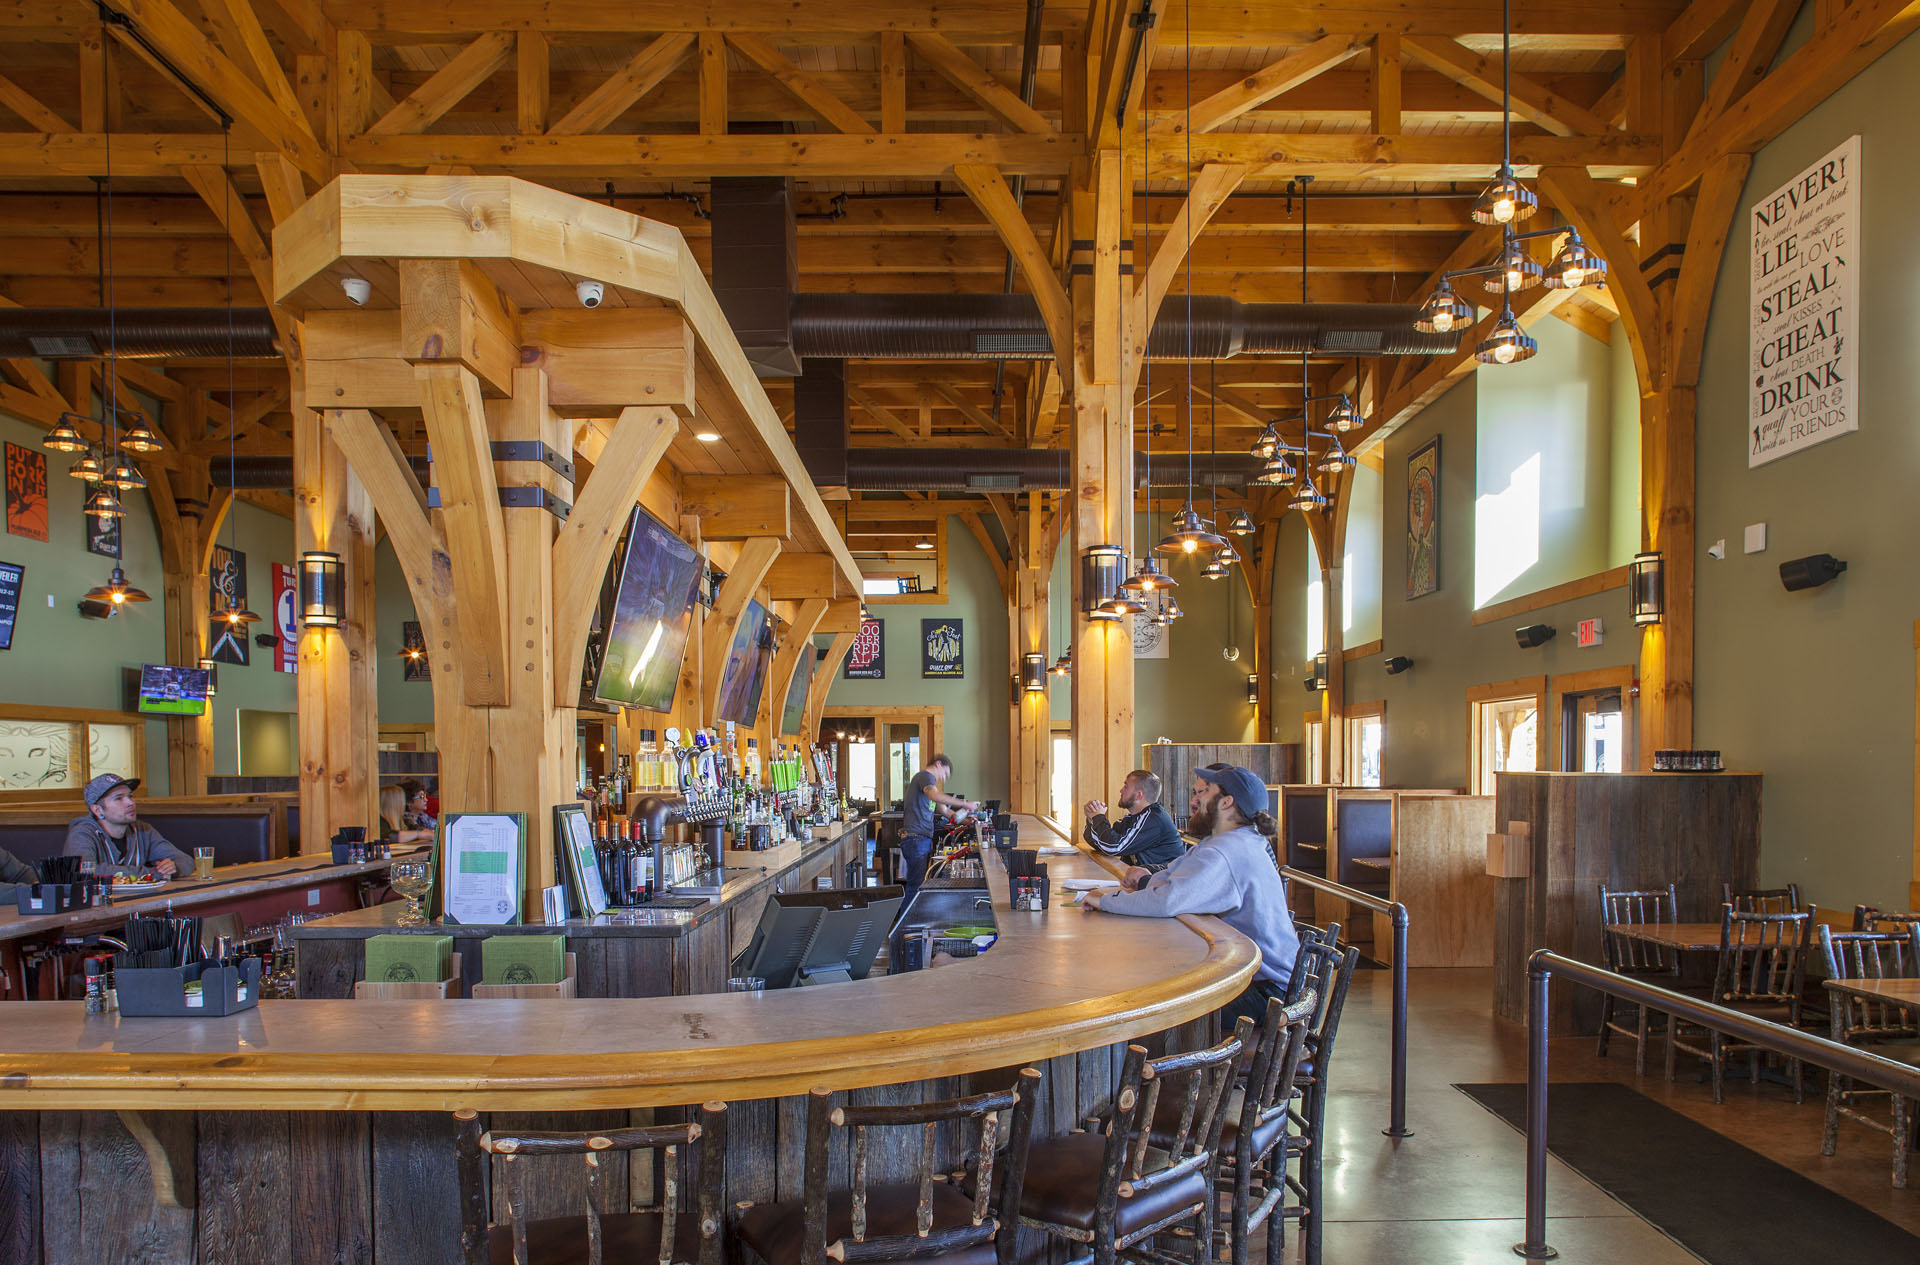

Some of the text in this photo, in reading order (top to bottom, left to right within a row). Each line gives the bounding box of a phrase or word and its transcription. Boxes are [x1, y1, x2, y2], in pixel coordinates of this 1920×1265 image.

[1761, 233, 1799, 278] LIE
[1800, 227, 1845, 269] LOVE
[1761, 262, 1837, 324] STEAL
[1792, 298, 1823, 324] KISSES
[1760, 306, 1842, 369] CHEAT
[1791, 346, 1825, 372] DEATH
[1760, 356, 1845, 417] DRINK
[1790, 394, 1830, 421] YOUR
[1790, 406, 1846, 442] FRIENDS
[8, 460, 46, 485] FORK
[35, 454, 45, 468] A
[8, 475, 23, 495] IN
[1580, 618, 1595, 645] EXIT
[853, 643, 880, 654] RED
